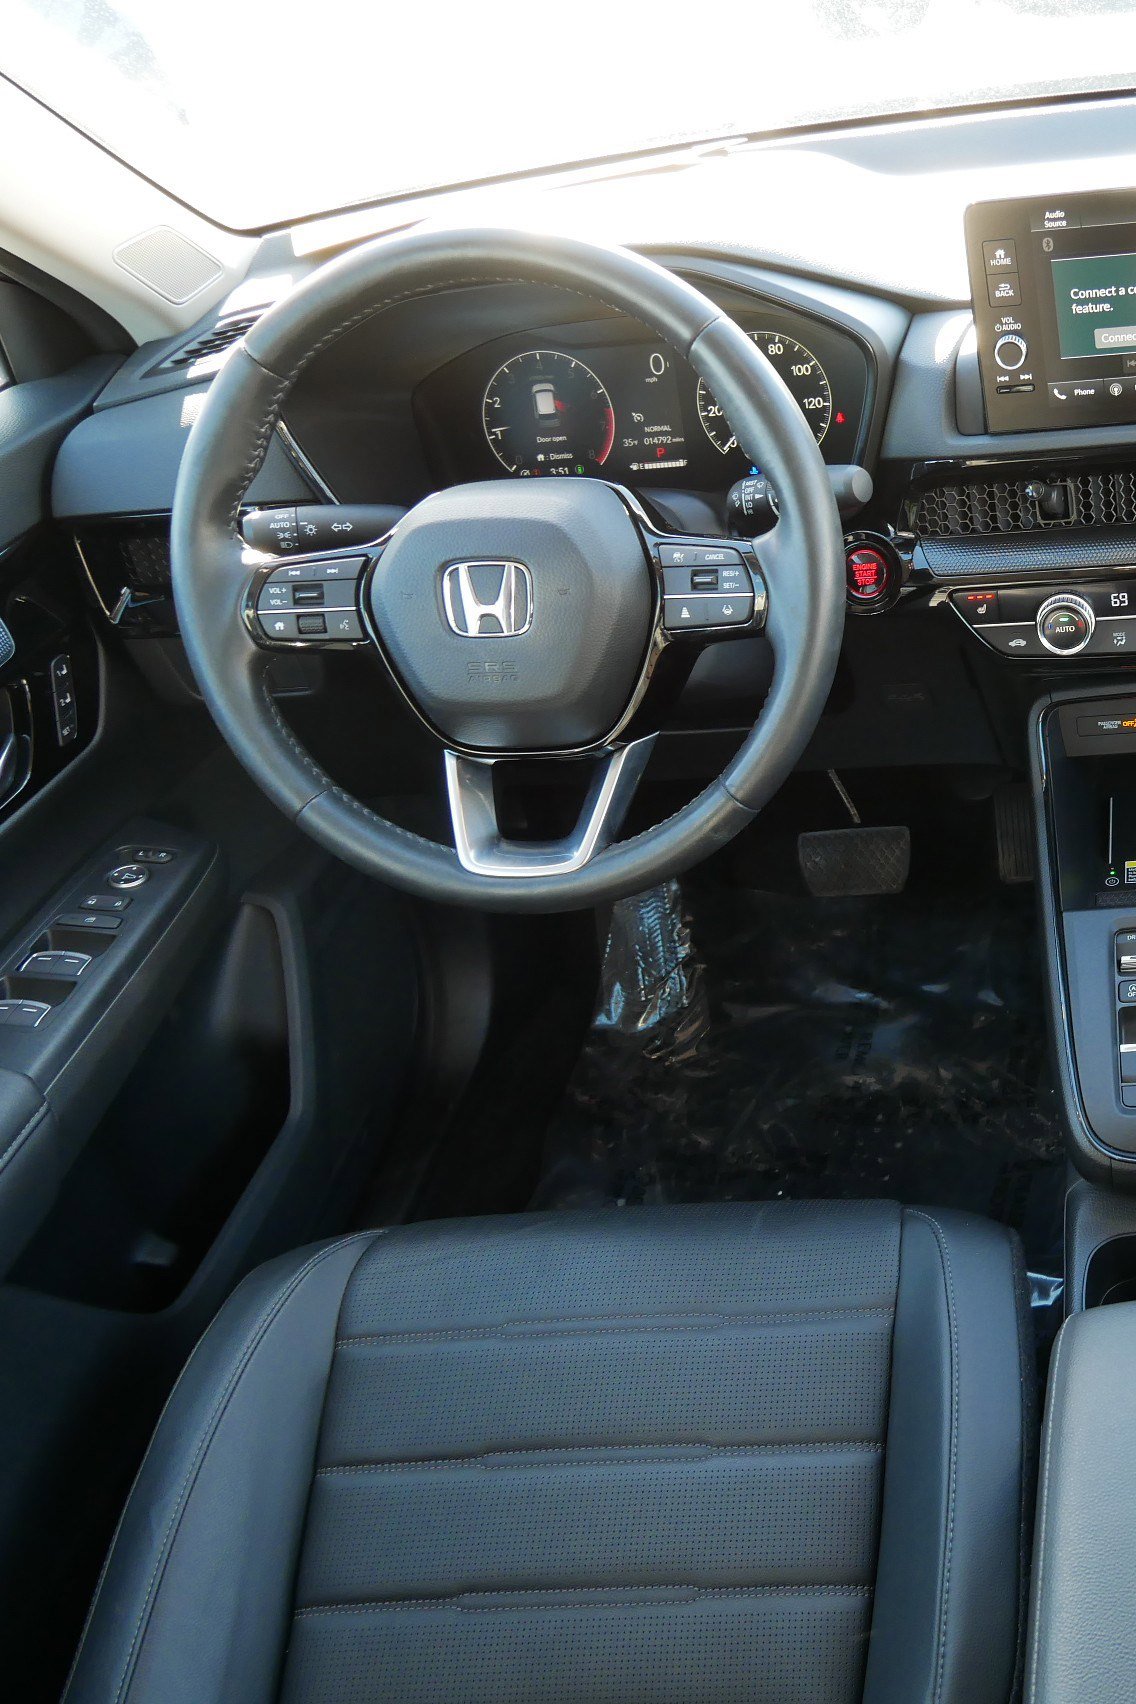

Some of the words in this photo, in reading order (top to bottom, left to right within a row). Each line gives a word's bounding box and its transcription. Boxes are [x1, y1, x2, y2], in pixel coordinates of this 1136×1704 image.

[1044, 210, 1065, 219] Audio
[1044, 219, 1067, 228] Source
[990, 258, 1012, 266] HOME
[995, 289, 1014, 298] BACK
[1070, 285, 1117, 300] Connect
[1118, 287, 1126, 296] a
[1071, 303, 1114, 314] feature.
[1002, 322, 1022, 330] AUDIO
[768, 343, 784, 355] 80
[650, 353, 665, 375] 0
[791, 364, 811, 376] 100
[645, 376, 658, 384] mph
[1074, 387, 1095, 396] Phone
[493, 397, 501, 408] 2
[803, 397, 824, 409] 120
[708, 405, 724, 416] 20
[645, 424, 672, 433] NORMAL
[496, 430, 502, 440] 1
[552, 435, 567, 443] open
[644, 435, 672, 446] 014792
[549, 452, 573, 460] Dismiss
[657, 447, 666, 458] P
[550, 467, 569, 475] 3:51
[744, 486, 755, 494] OFF
[270, 521, 290, 529] AUTO
[704, 553, 725, 561] CANCEL
[1110, 593, 1129, 607] 69
[1055, 624, 1075, 633] AUTO
